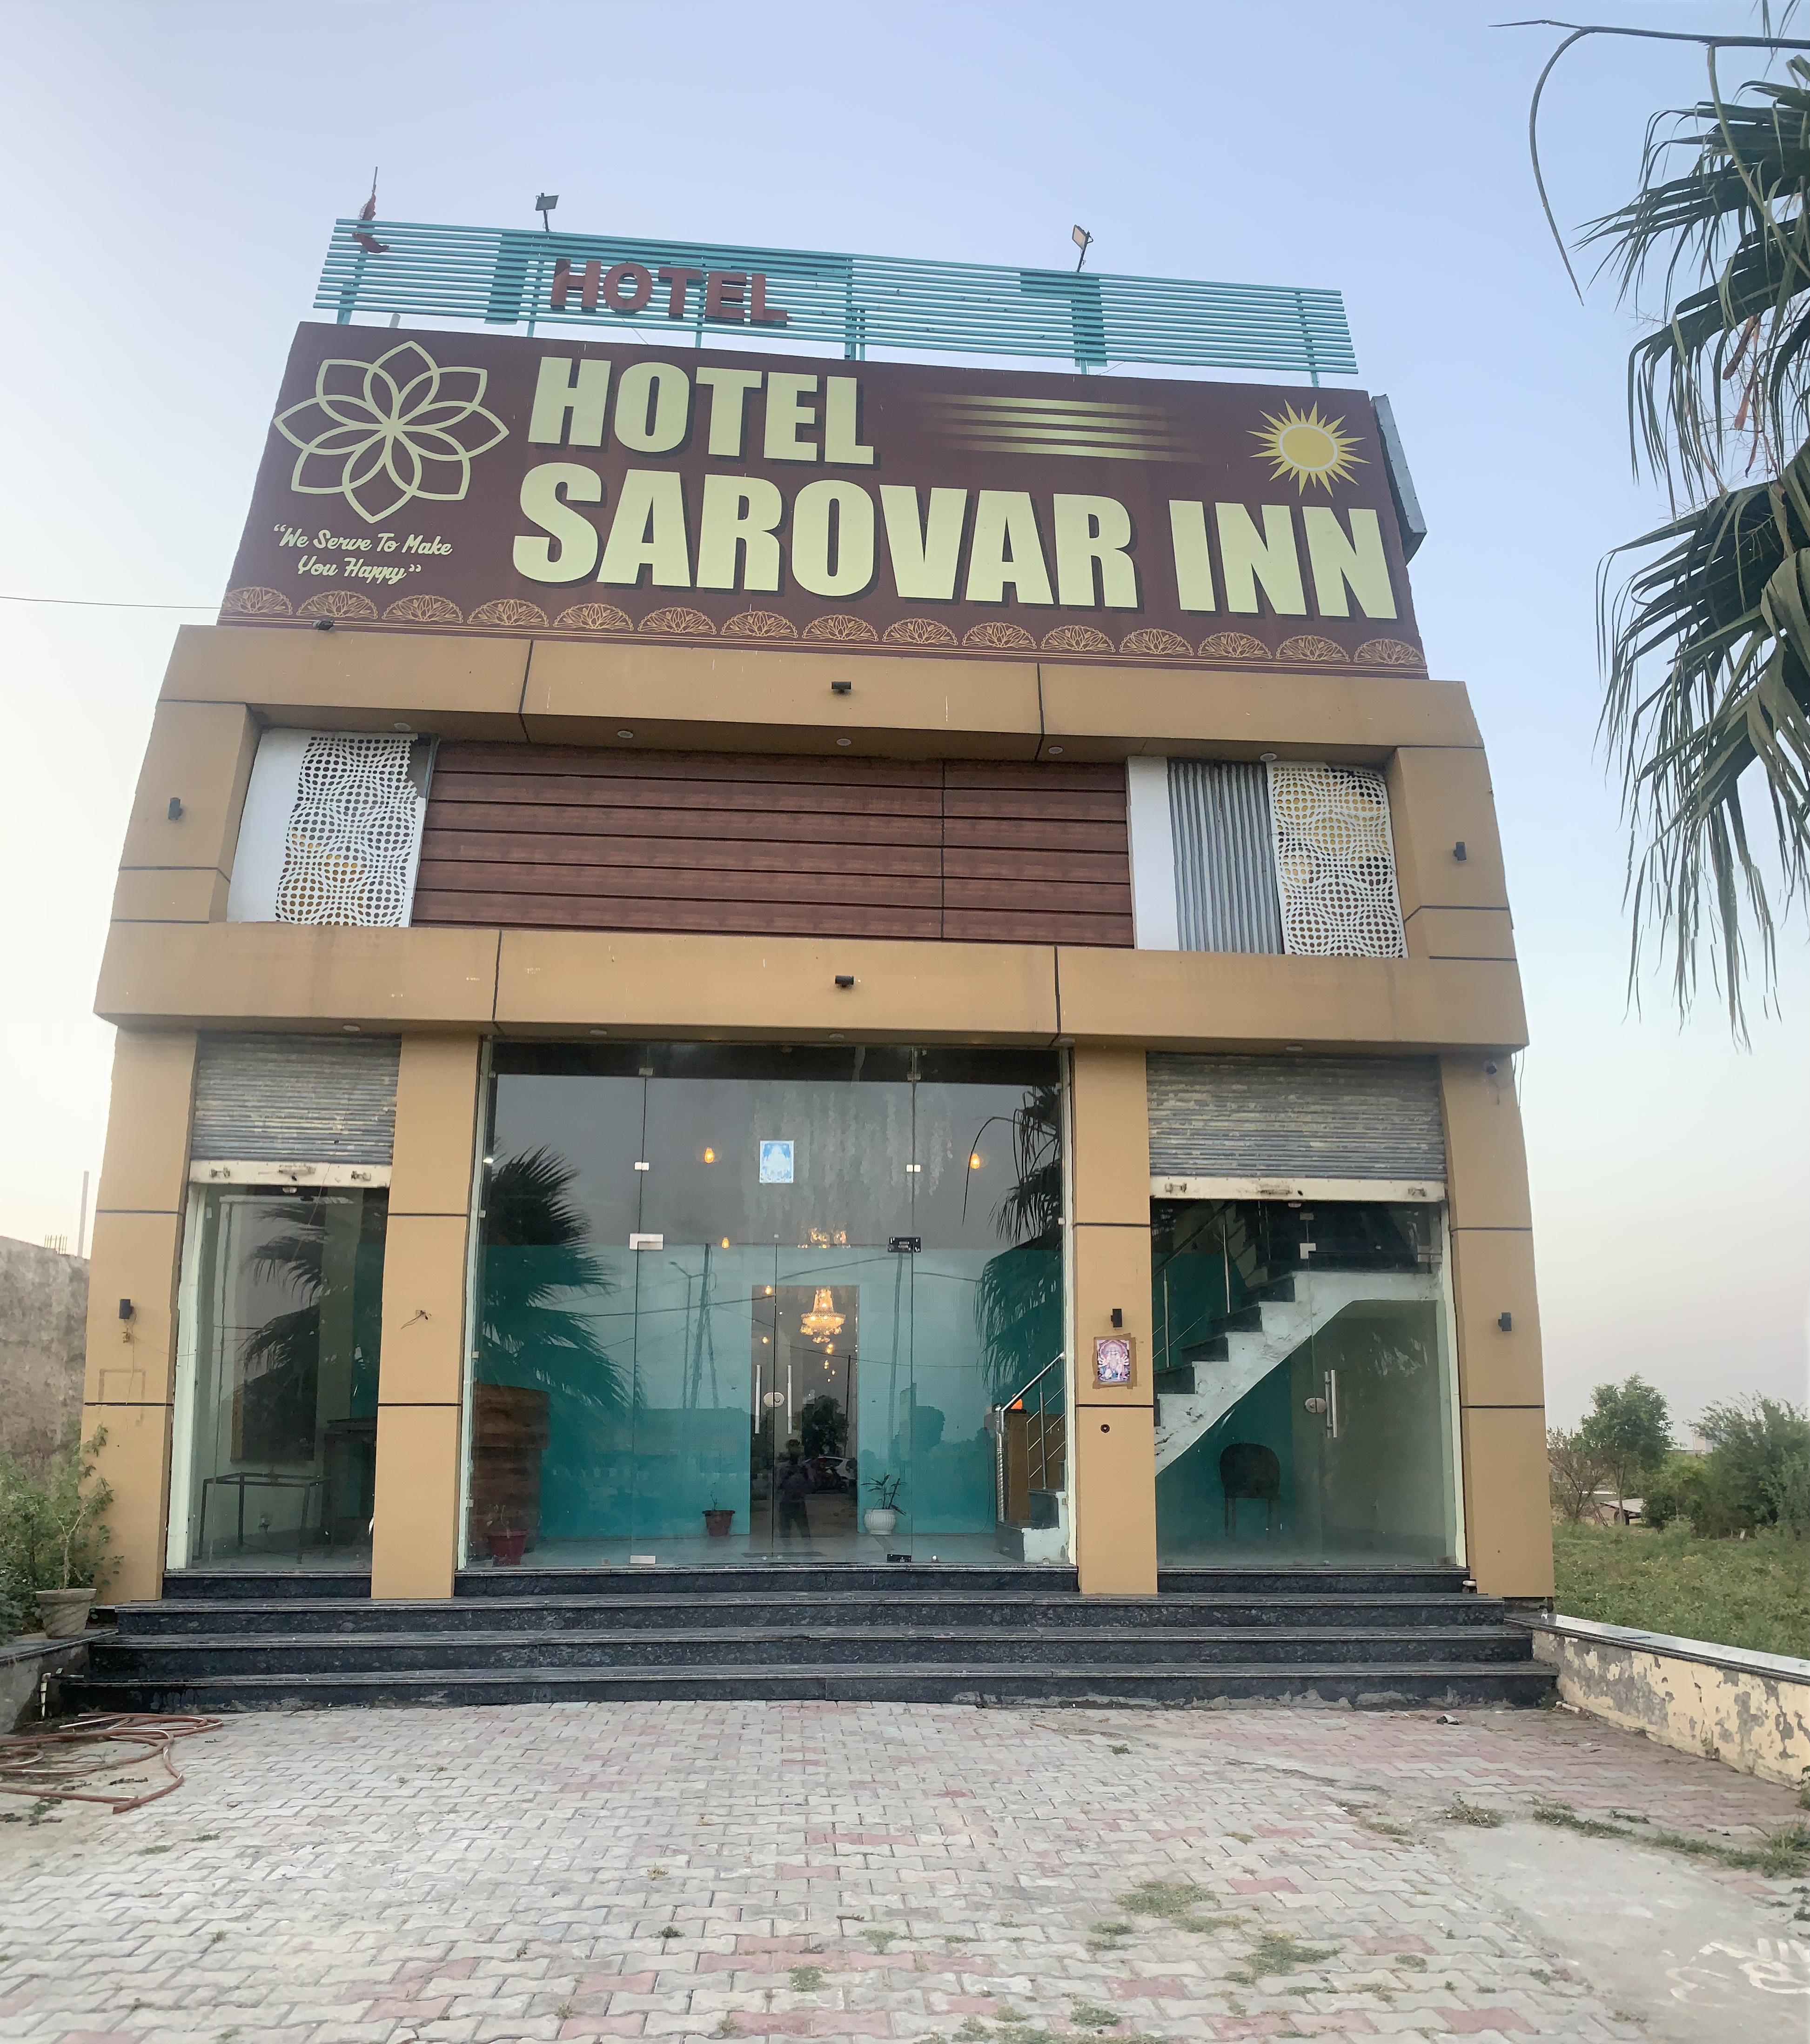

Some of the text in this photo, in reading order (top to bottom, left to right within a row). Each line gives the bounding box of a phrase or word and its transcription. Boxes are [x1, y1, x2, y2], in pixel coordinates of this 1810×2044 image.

[550, 258, 788, 327] HOTEL
[528, 356, 874, 465] HOTEL
[297, 555, 339, 577] You
[313, 529, 373, 551] Serve
[376, 532, 401, 553] To
[401, 534, 453, 555] Make
[512, 462, 1398, 620] SAROVAR INN
